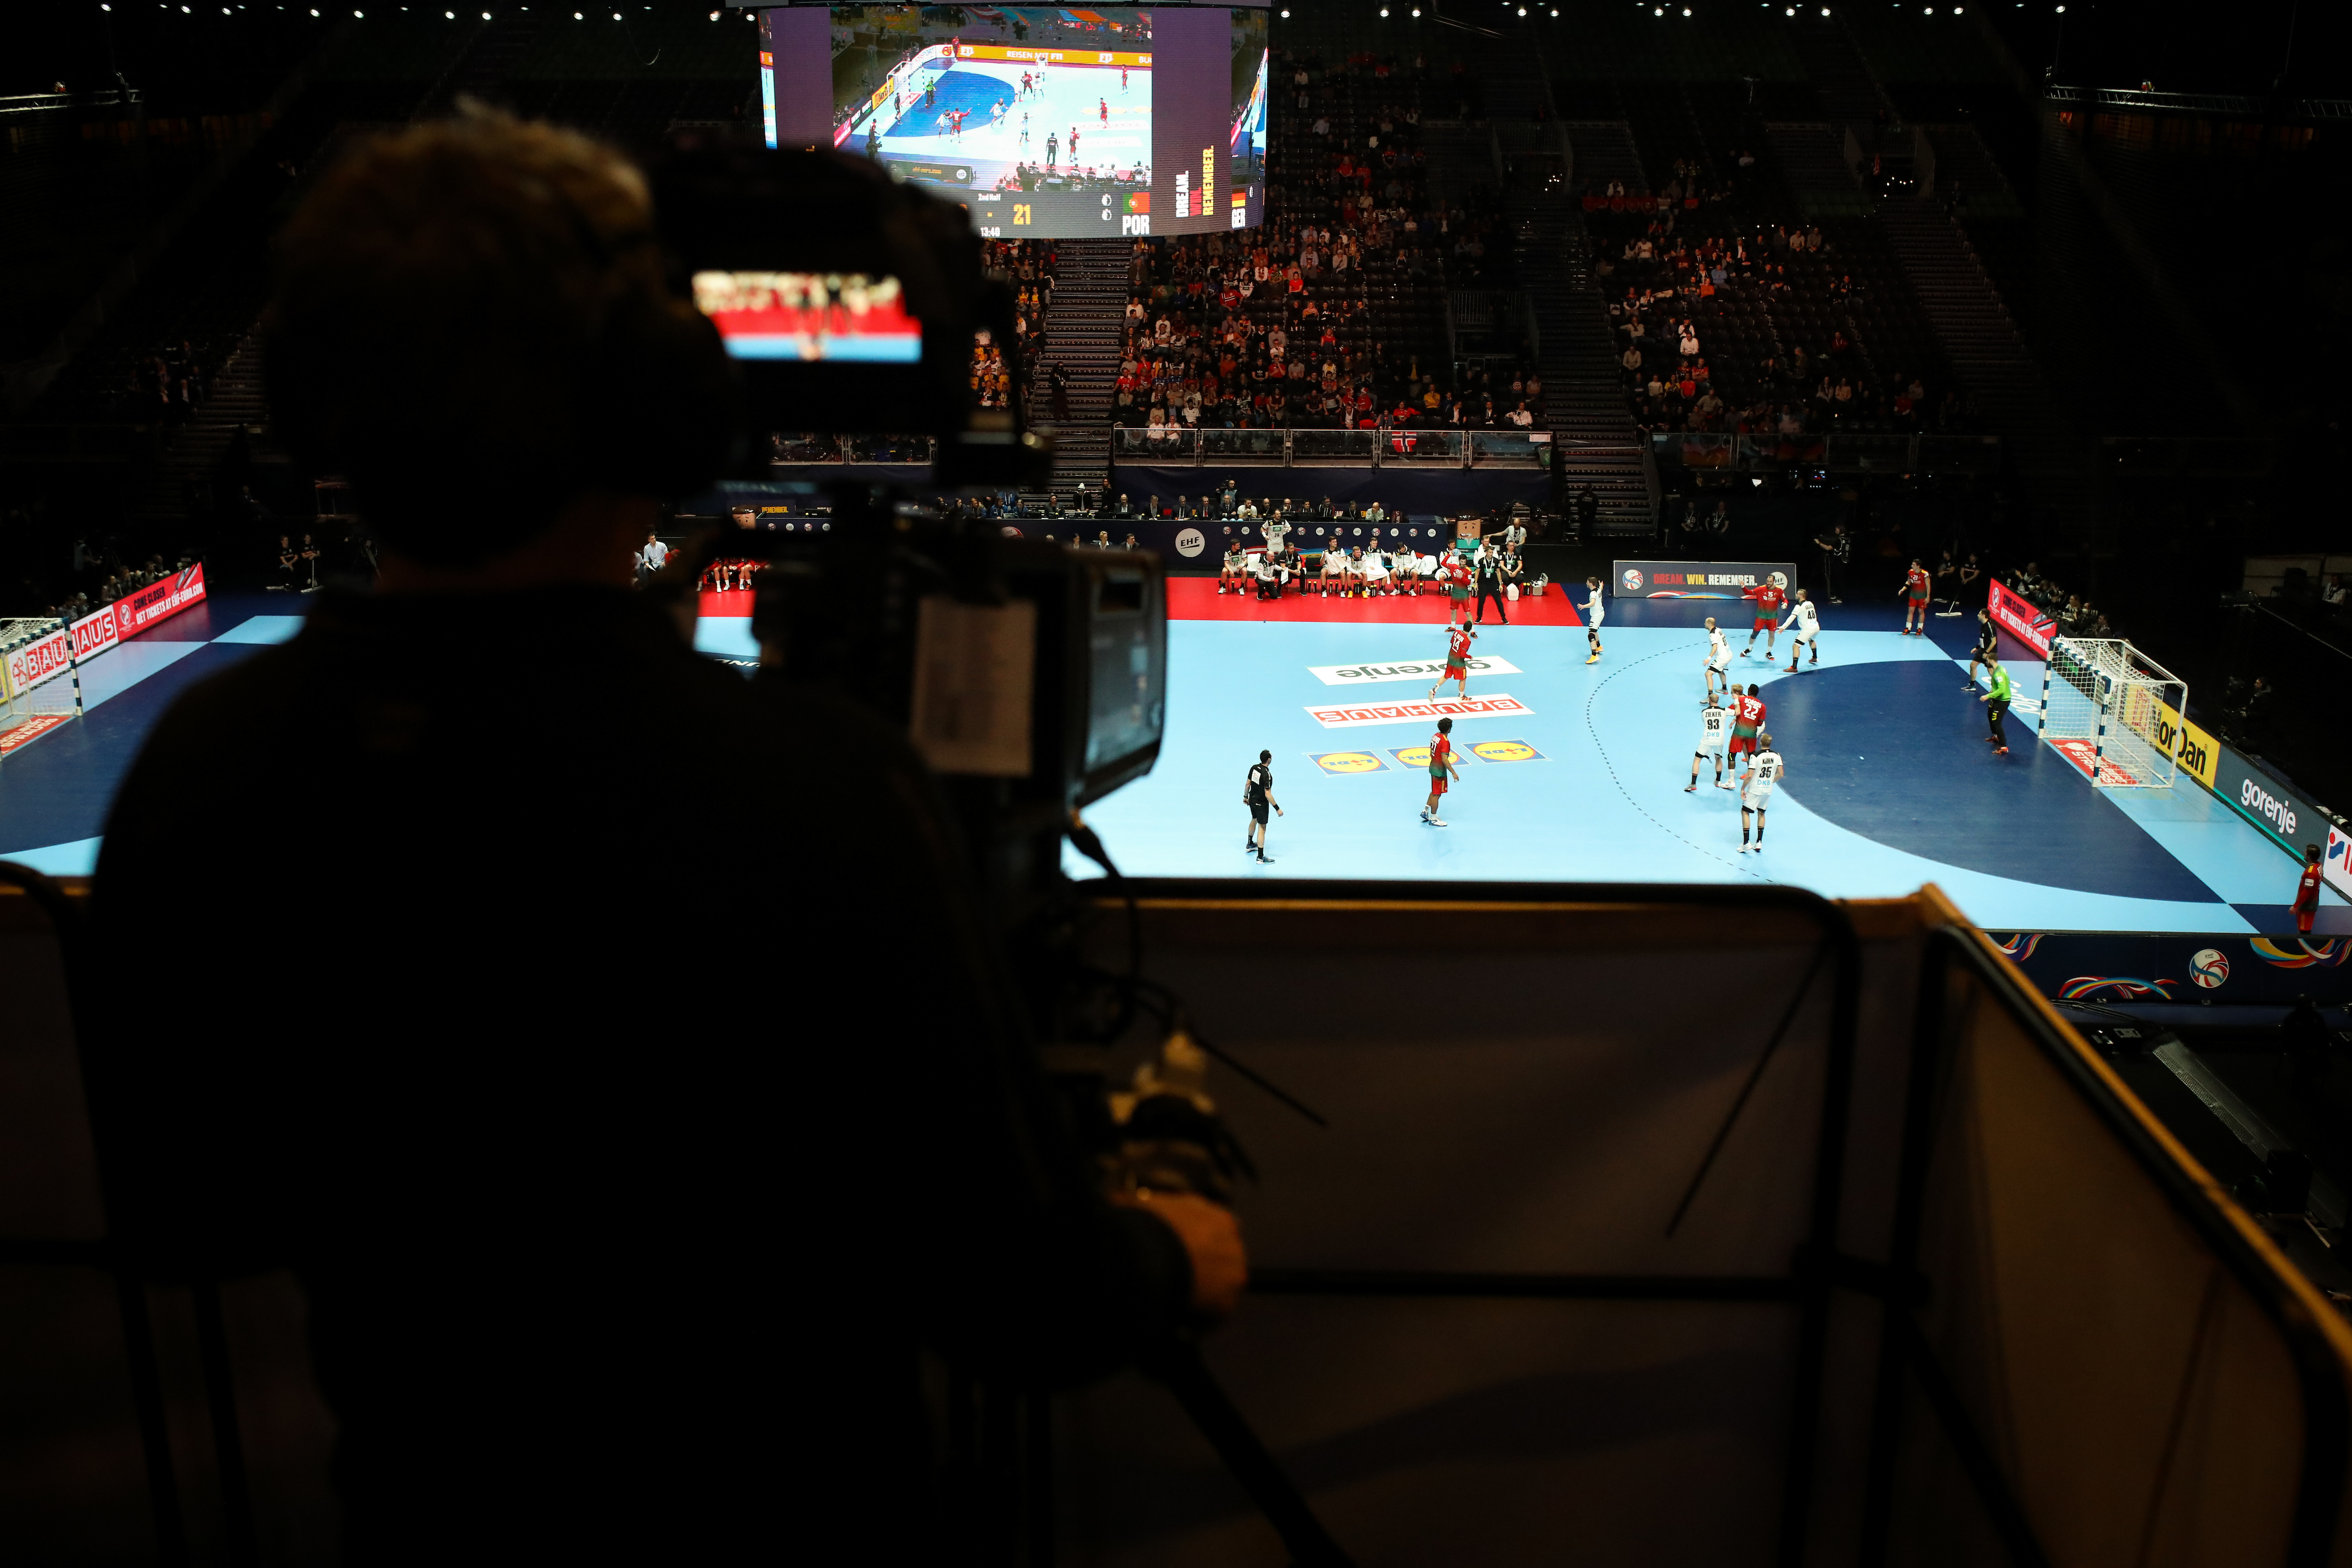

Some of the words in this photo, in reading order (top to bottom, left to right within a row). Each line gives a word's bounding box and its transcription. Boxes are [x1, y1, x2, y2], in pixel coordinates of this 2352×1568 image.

[1006, 50, 1032, 59] REISEN
[1202, 145, 1214, 216] REMEMBER.
[978, 193, 989, 201] 2nd
[989, 193, 1001, 201] Half
[1176, 170, 1189, 218] DREAM.
[1189, 187, 1202, 217] WIN.
[1013, 203, 1031, 225] 21
[1231, 208, 1246, 229] GER
[1122, 214, 1150, 236] POR
[1180, 536, 1200, 547] EHF
[1653, 573, 1686, 585] DREAM.
[1687, 574, 1707, 585] WIN.
[1708, 574, 1758, 586] REMEMBER.
[134, 593, 147, 611] COME
[148, 587, 166, 604] CLOSER
[136, 610, 147, 625] GET
[146, 600, 166, 620] TICKETS
[166, 596, 172, 611] AT
[171, 582, 203, 608] EHF-EURO.COM
[1808, 610, 1815, 619] 48
[2007, 610, 2021, 633] TICKETS
[2020, 623, 2026, 635] AT
[2025, 626, 2049, 652] EHF-EURO.CO
[1453, 637, 1461, 650] 14
[1319, 699, 1515, 721] BAUHAUS
[1744, 698, 1762, 709] BORGES
[1744, 704, 1759, 719] 22
[1707, 719, 1719, 730] 93
[1759, 766, 1772, 778] 35
[2241, 778, 2297, 834] gorenje
